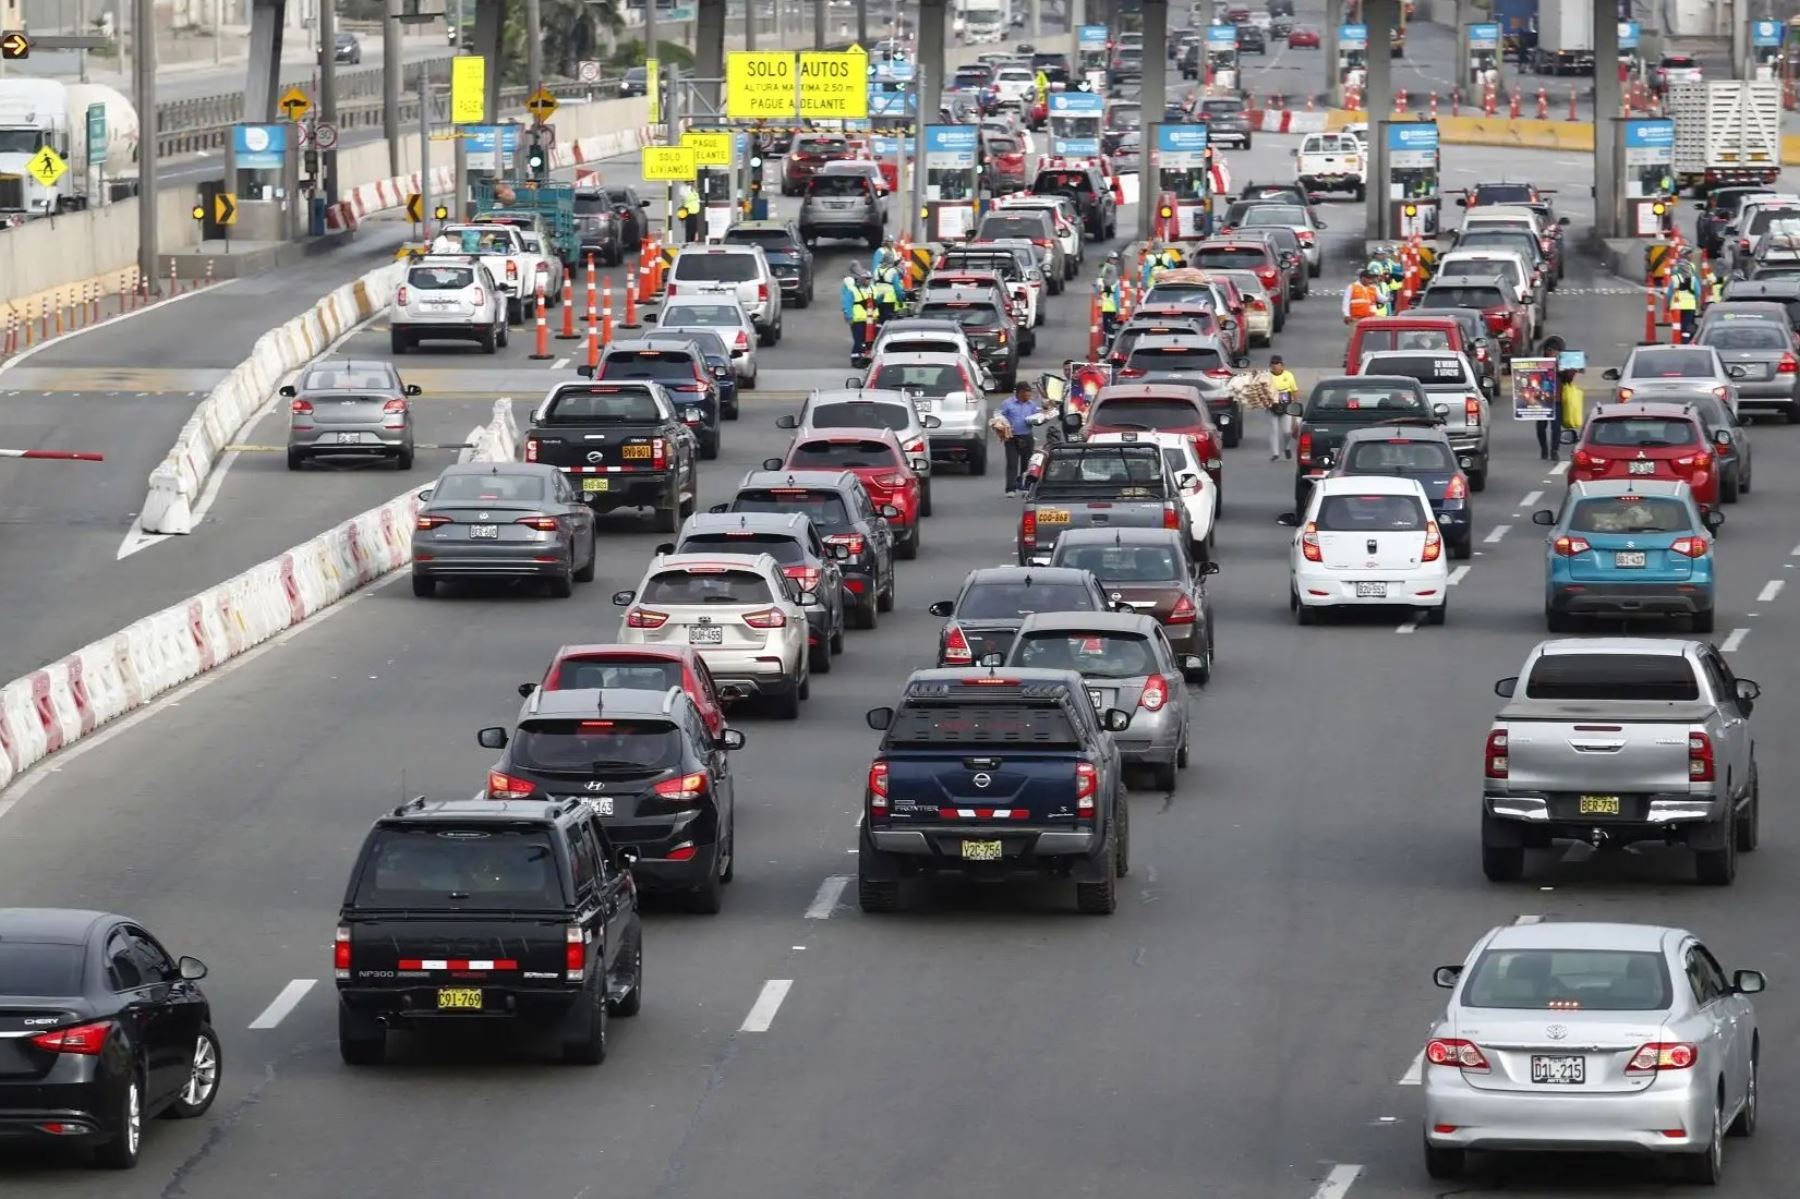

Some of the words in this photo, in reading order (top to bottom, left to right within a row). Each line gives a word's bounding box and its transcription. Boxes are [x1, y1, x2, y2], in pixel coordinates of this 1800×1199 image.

[747, 61, 787, 77] SOLO
[800, 61, 849, 77] AUTOS
[744, 83, 779, 92] ALTURA
[750, 98, 784, 109] PAGUE
[788, 98, 846, 109] ADELANTE
[693, 139, 718, 148] PAGUE
[658, 152, 681, 162] SOLO
[696, 150, 726, 160] ELANTE
[650, 164, 689, 174] LIVIANOS
[1581, 800, 1618, 812] BER-731
[358, 970, 395, 978] NP300
[438, 993, 482, 1007] C91-769
[1534, 1063, 1582, 1079] D1L-215
